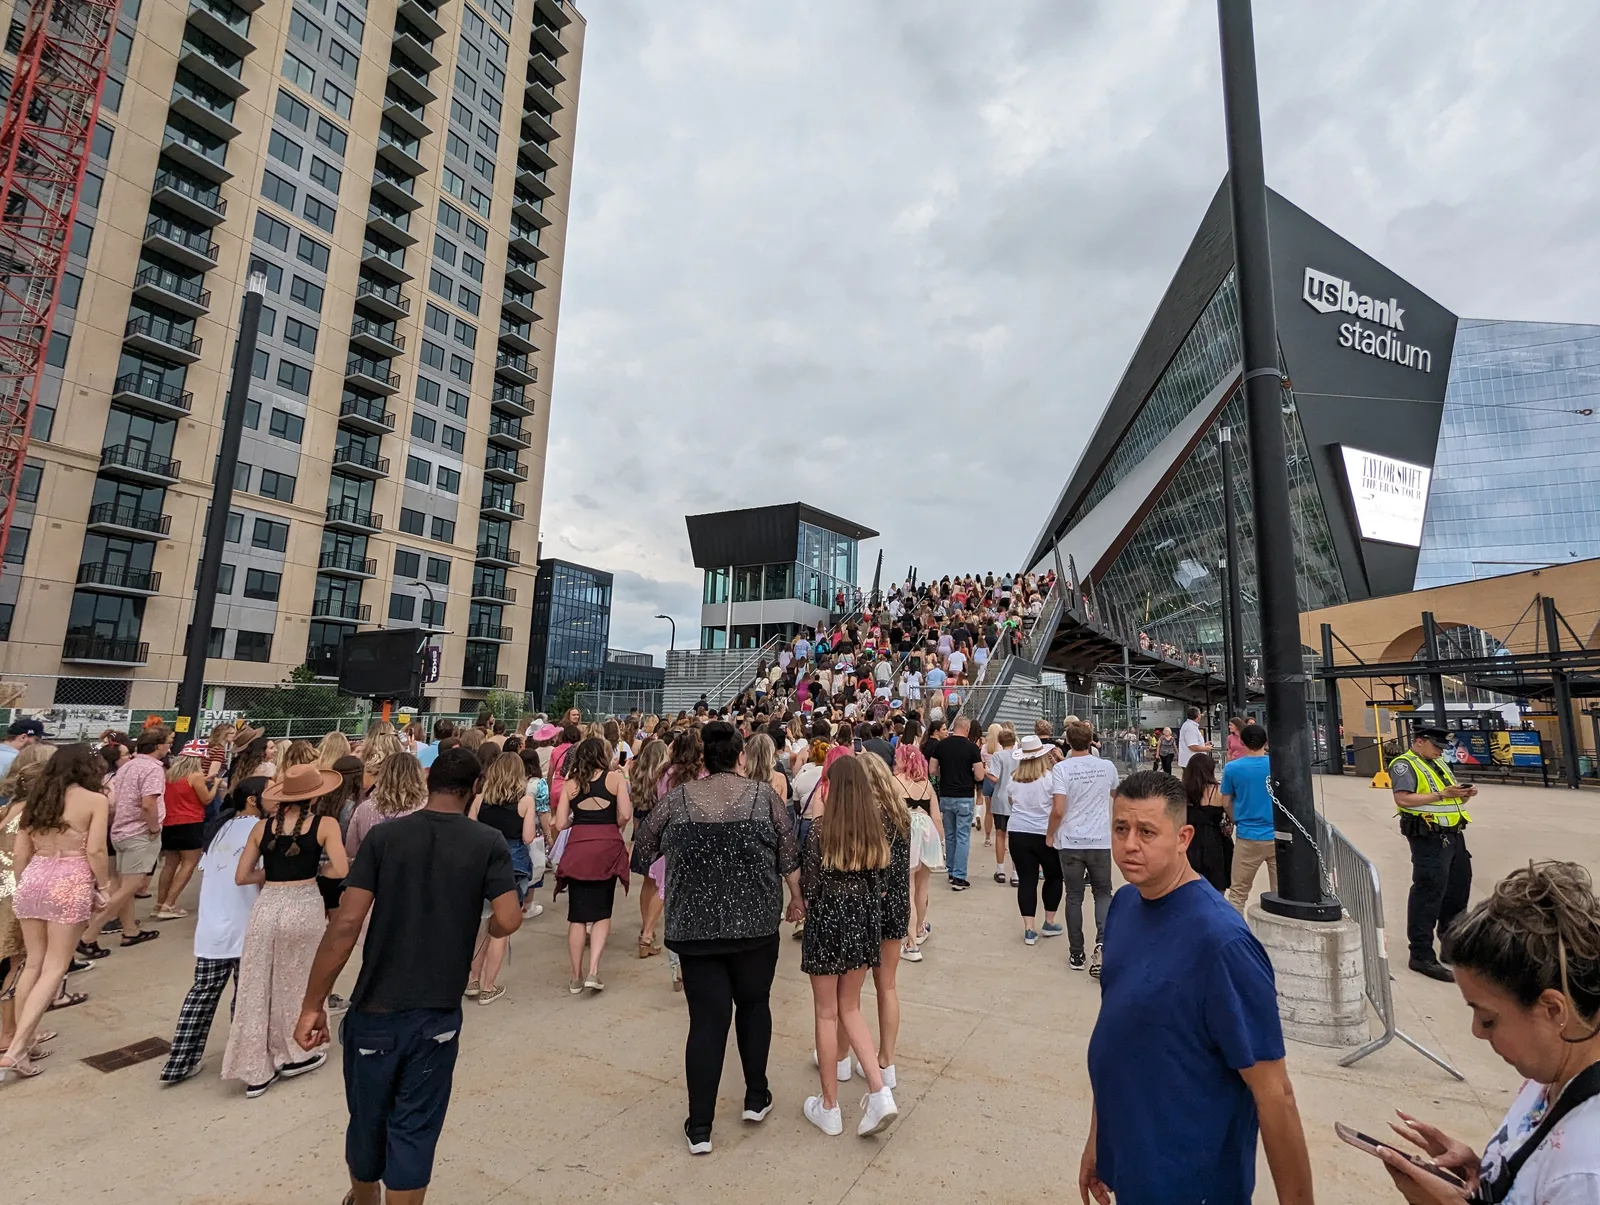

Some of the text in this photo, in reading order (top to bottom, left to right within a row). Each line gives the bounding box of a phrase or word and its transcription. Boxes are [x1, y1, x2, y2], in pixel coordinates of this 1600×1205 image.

[1338, 321, 1431, 373] stadium
[1362, 456, 1422, 489] TAYLOR SWIFT
[1362, 477, 1421, 500] THE ERAS TOUR
[430, 650, 438, 681] SKOL
